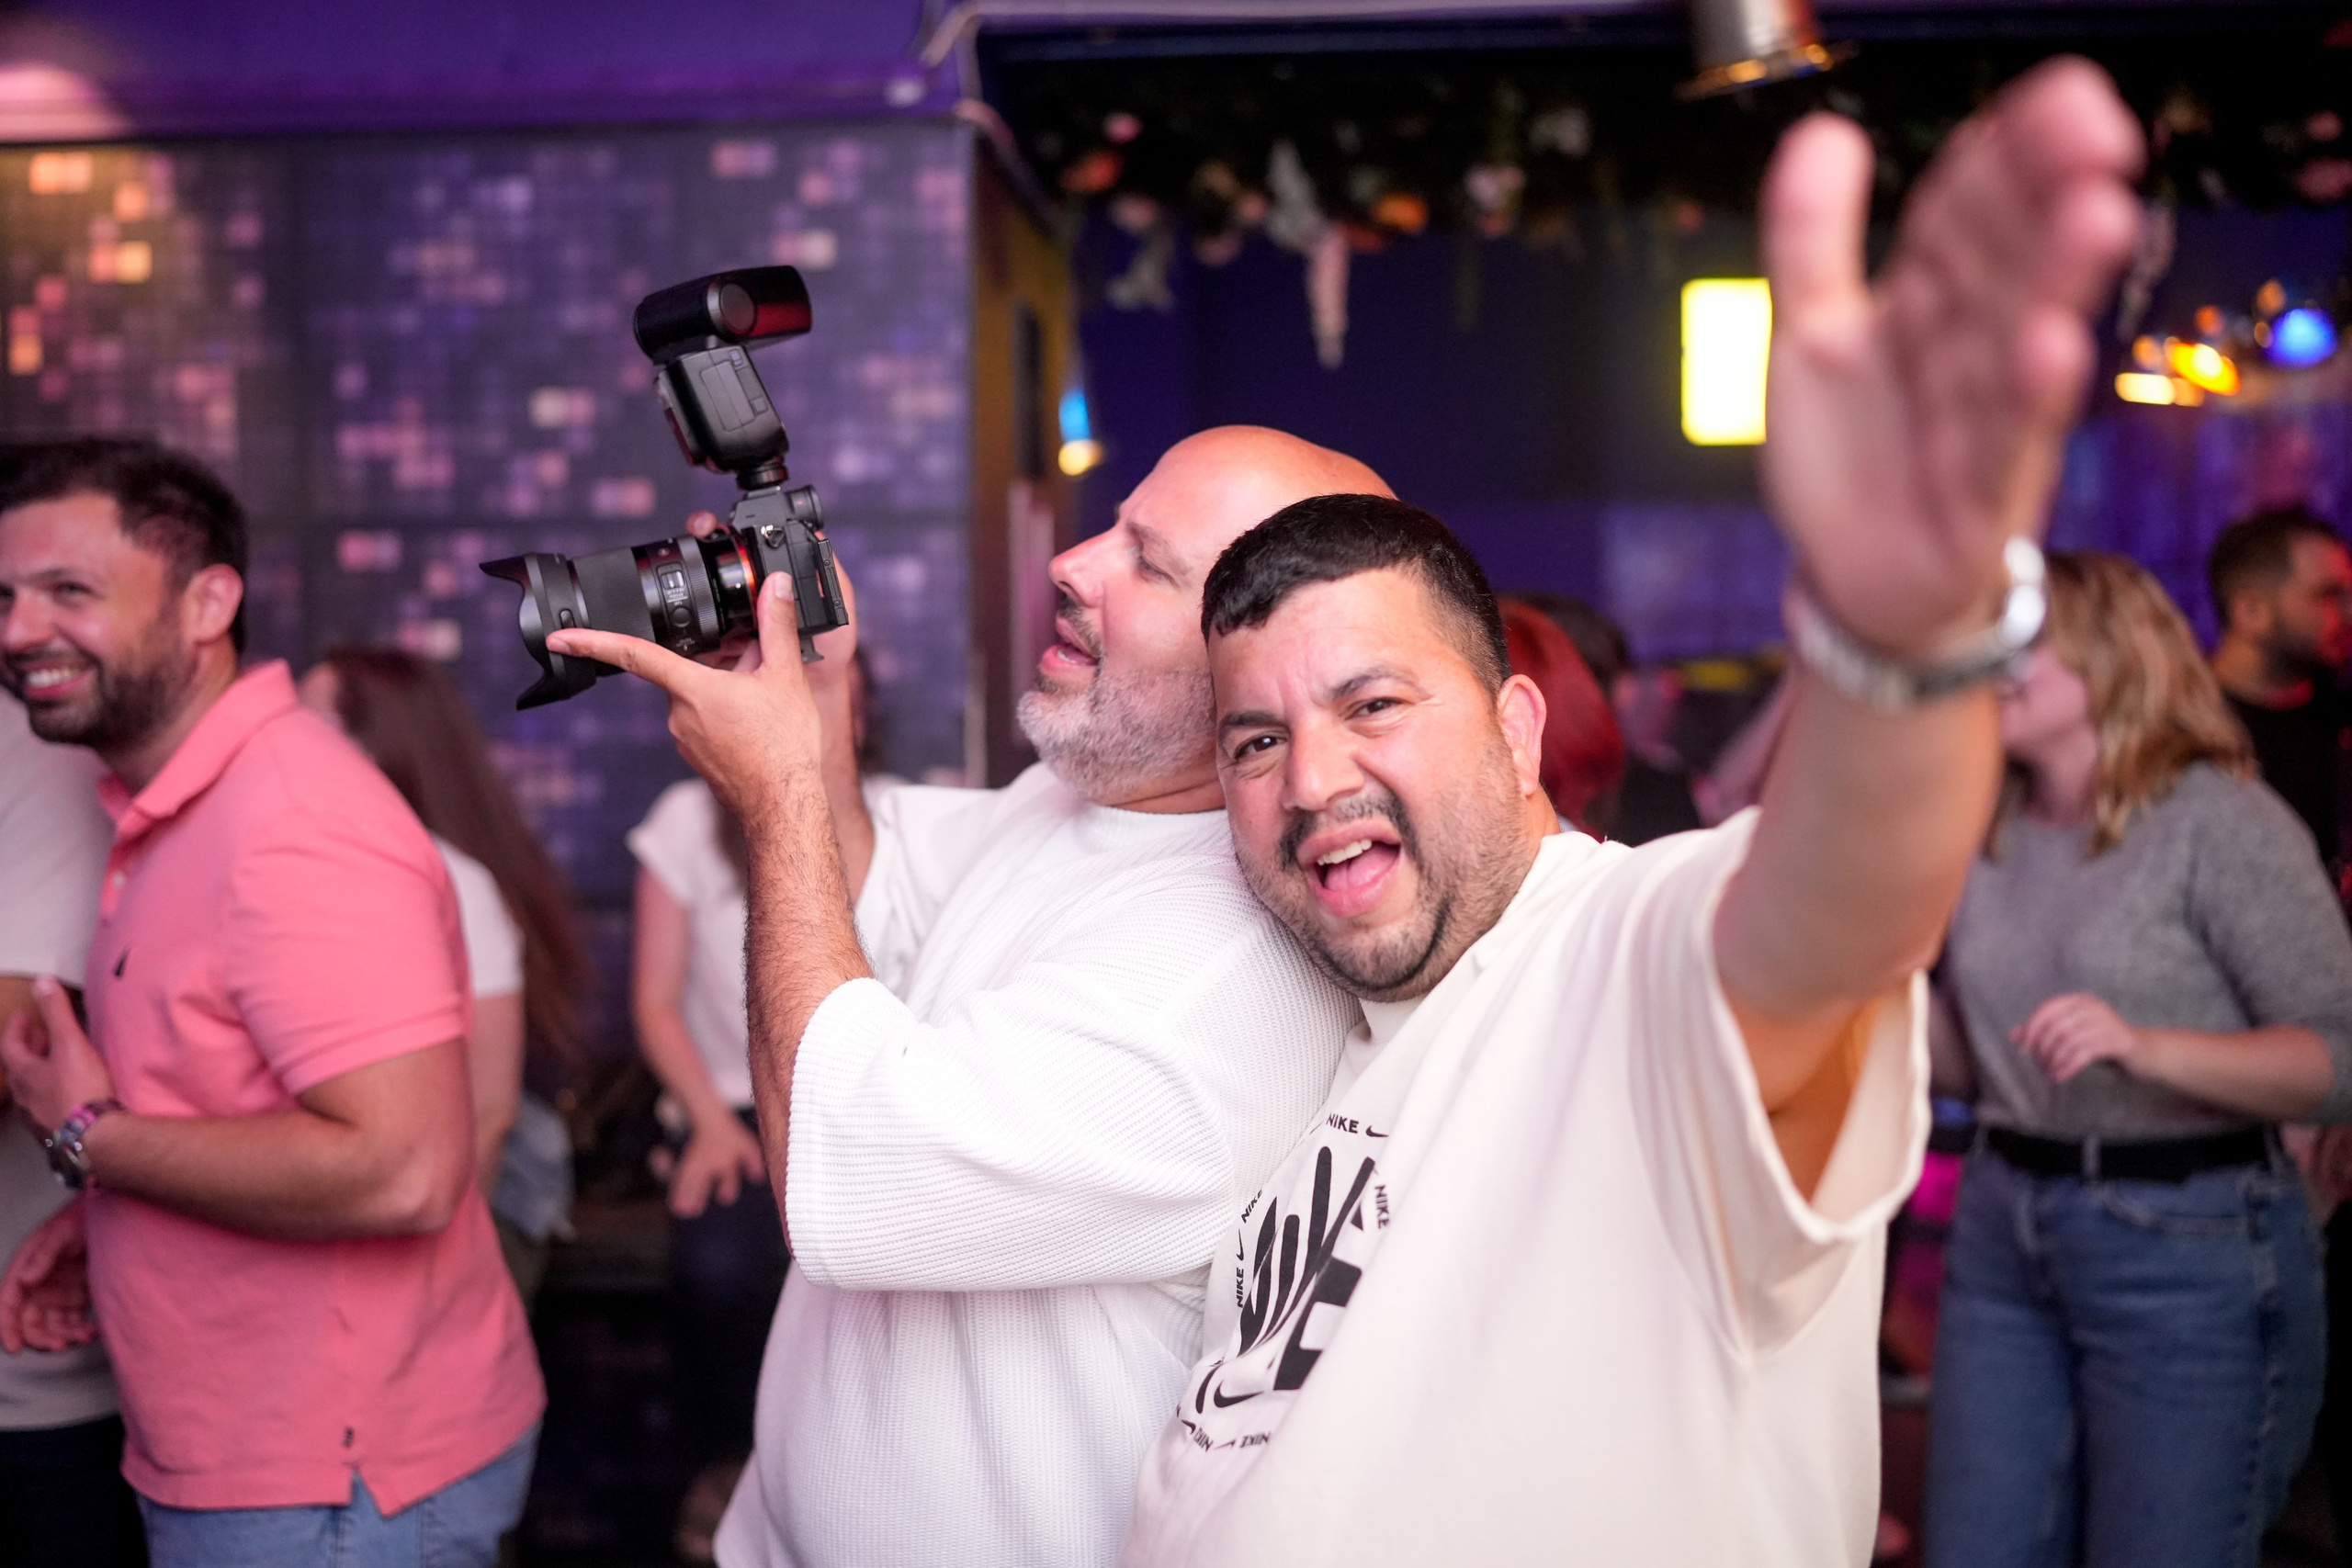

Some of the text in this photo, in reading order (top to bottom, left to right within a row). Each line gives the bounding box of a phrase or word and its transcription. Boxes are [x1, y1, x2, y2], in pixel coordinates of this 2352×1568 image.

[1326, 1112, 1359, 1134] NIKE
[1240, 1189, 1262, 1224] NIKE
[1374, 1184, 1390, 1229] NIKE
[1236, 1267, 1244, 1308] NIKE
